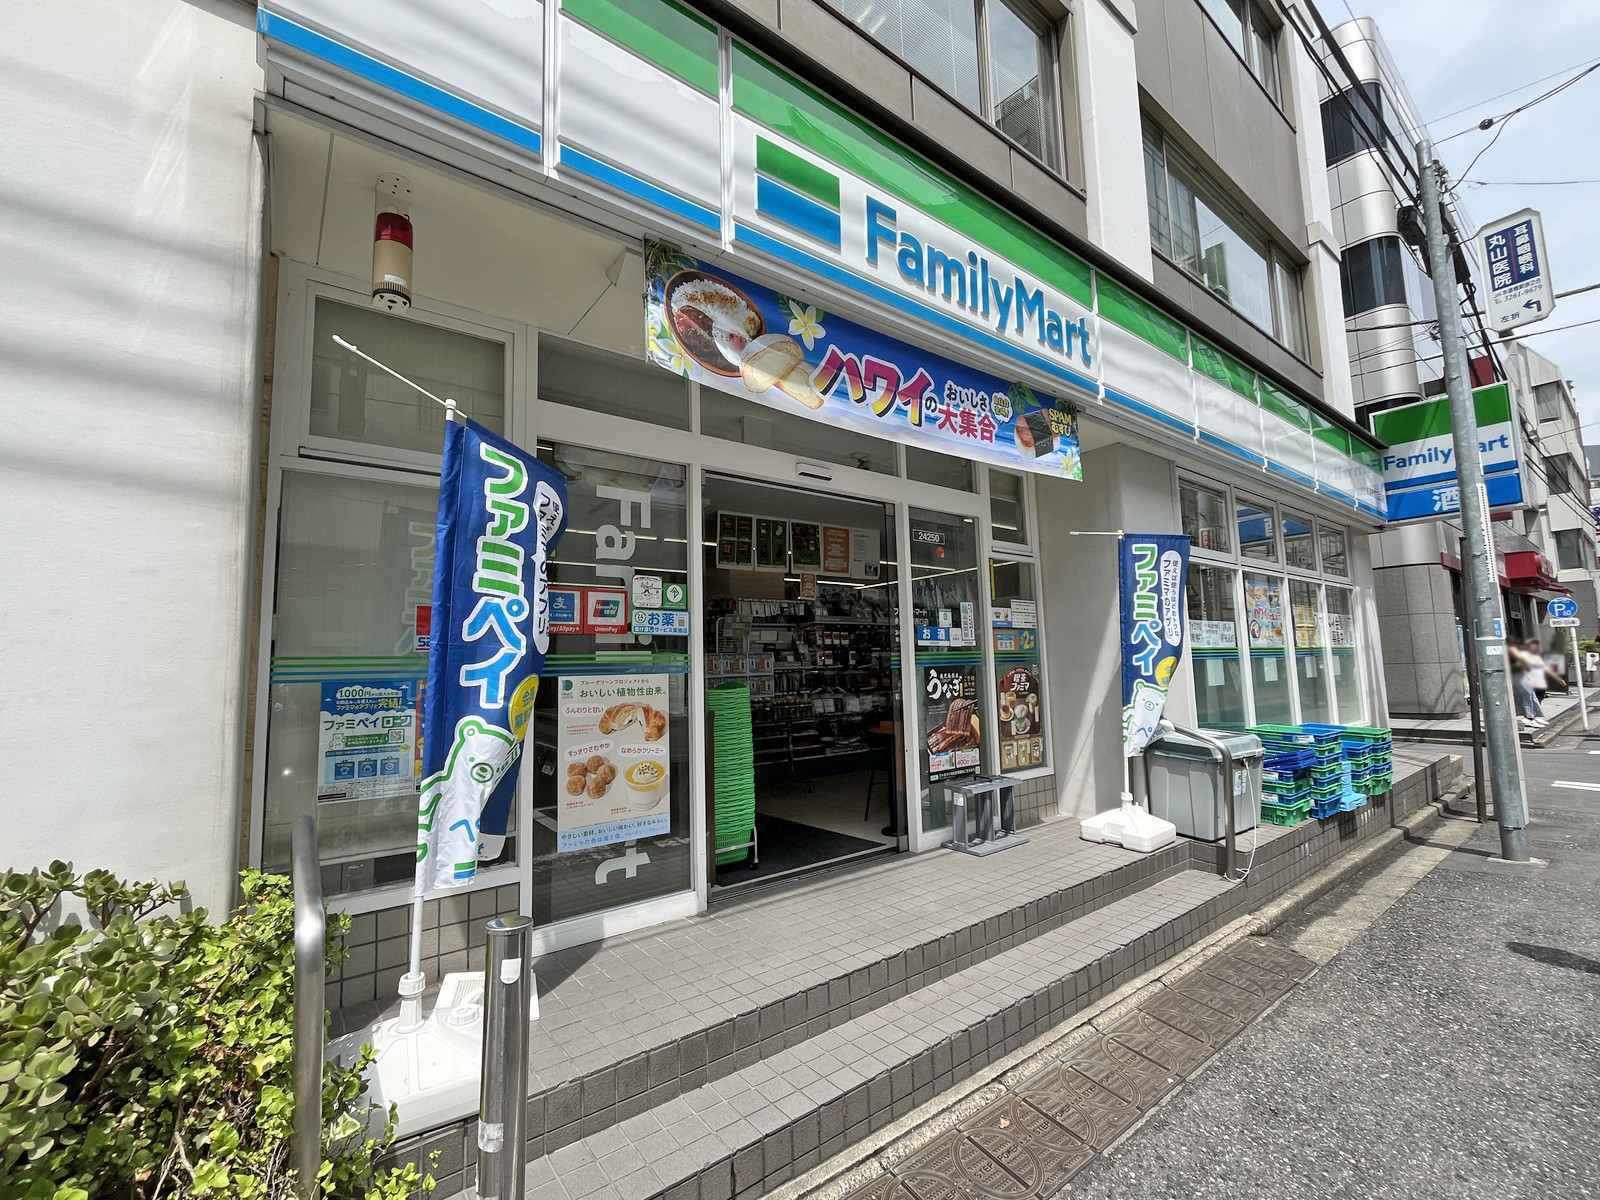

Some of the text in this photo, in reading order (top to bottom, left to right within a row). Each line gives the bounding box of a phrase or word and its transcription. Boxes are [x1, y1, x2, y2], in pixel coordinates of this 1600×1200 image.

[1488, 234, 1512, 289] 丸山医院
[866, 194, 1092, 368] FamilyMart
[1504, 284, 1543, 302] 3261-9679
[1500, 311, 1520, 323] 左折
[945, 382, 990, 413] おいしさ
[938, 402, 997, 444] 大集合
[1048, 408, 1072, 426] SPAM
[1051, 421, 1072, 437] むすび
[1384, 434, 1509, 471] Familyart
[1432, 487, 1459, 511] 酒
[918, 531, 940, 543] 24250
[461, 442, 529, 709] ファミペイ
[1163, 559, 1173, 637] ファミマのアプリ
[1131, 543, 1163, 676] ファミペイ
[1554, 603, 1566, 617] P
[648, 612, 675, 627] お薬
[927, 669, 962, 699] うなぎ
[1013, 673, 1027, 682] 喫茶
[580, 686, 666, 698] おいしい植物性由来。
[1010, 682, 1030, 691] ファミマ
[565, 706, 604, 714] ふんわりと甘い
[323, 716, 411, 731] ファミペイ ローン
[567, 742, 611, 757] すっきりさわやか
[1082, 1084, 1097, 1097] STEP
[1033, 1121, 1050, 1135] STEP
[974, 1143, 1020, 1180] STEP POWER
